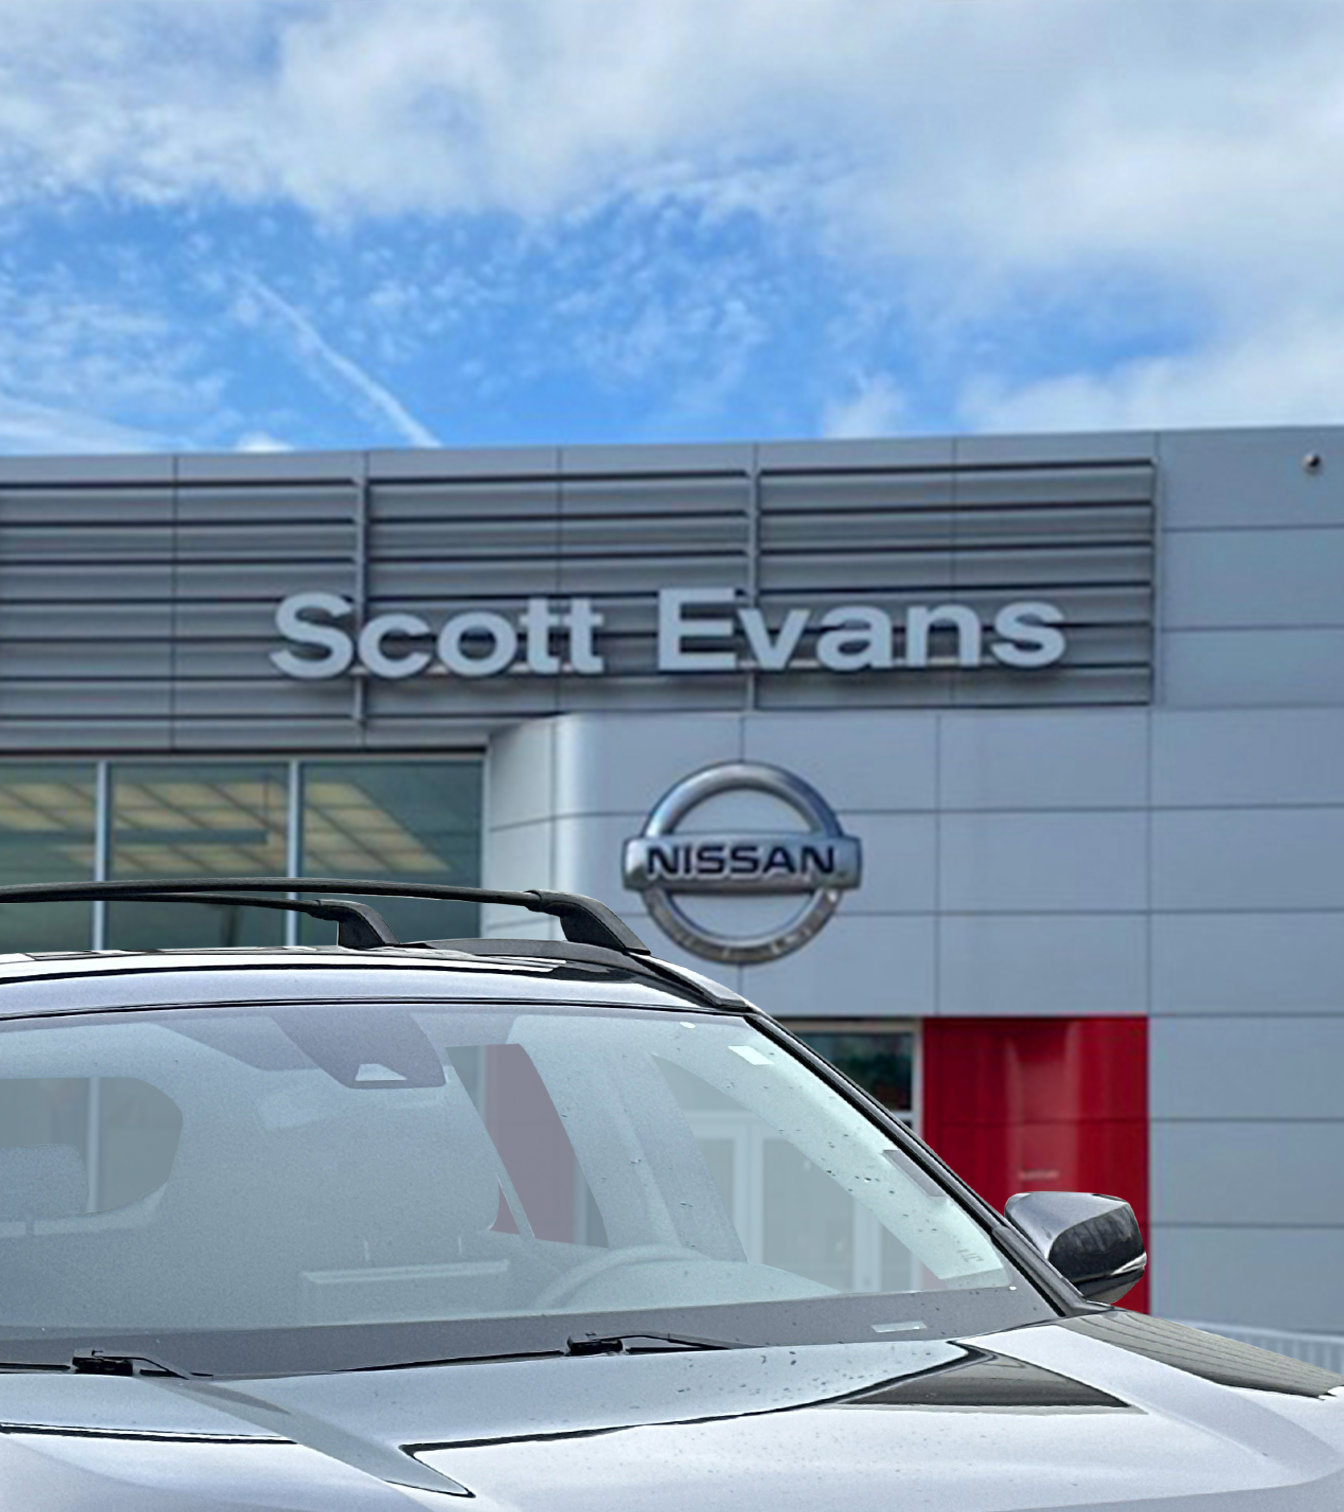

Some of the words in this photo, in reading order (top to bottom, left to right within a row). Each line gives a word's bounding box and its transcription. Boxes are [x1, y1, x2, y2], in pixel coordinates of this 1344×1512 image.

[269, 591, 604, 681] Scott
[657, 587, 1067, 674] Evans
[646, 845, 834, 875] NISSAN
